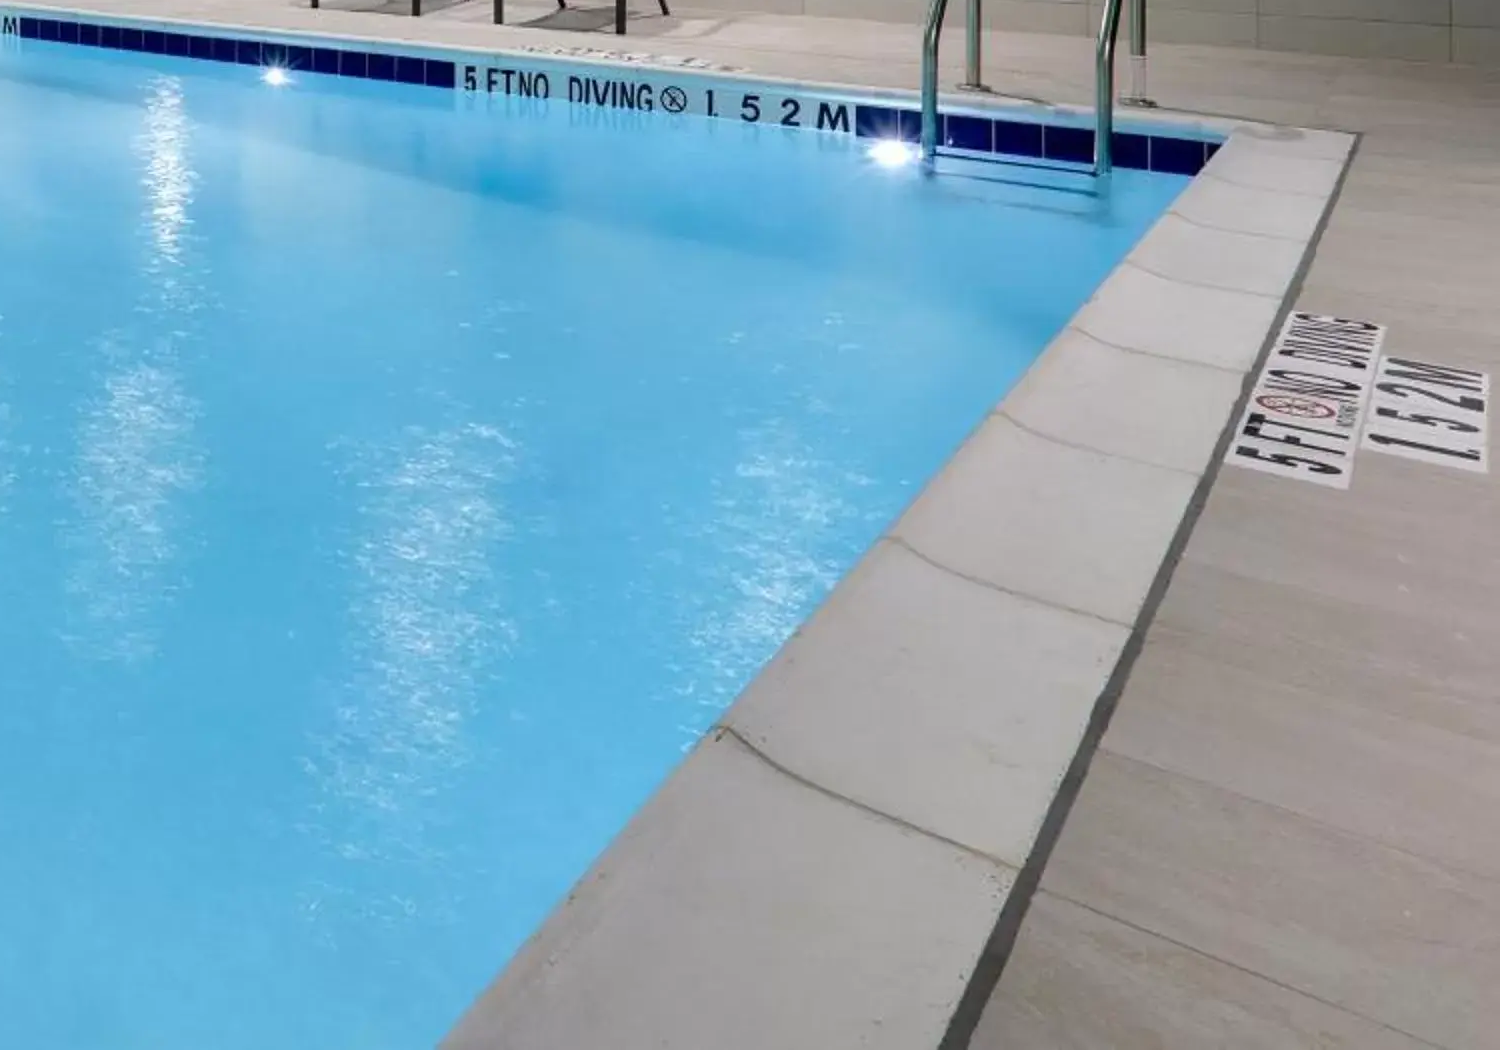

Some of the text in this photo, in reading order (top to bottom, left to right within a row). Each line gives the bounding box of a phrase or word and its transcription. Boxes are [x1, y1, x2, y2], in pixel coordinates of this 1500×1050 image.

[463, 65, 478, 92] 5
[568, 75, 654, 113] DIVING
[1243, 412, 1350, 457] FT
[1235, 446, 1343, 475] 5
